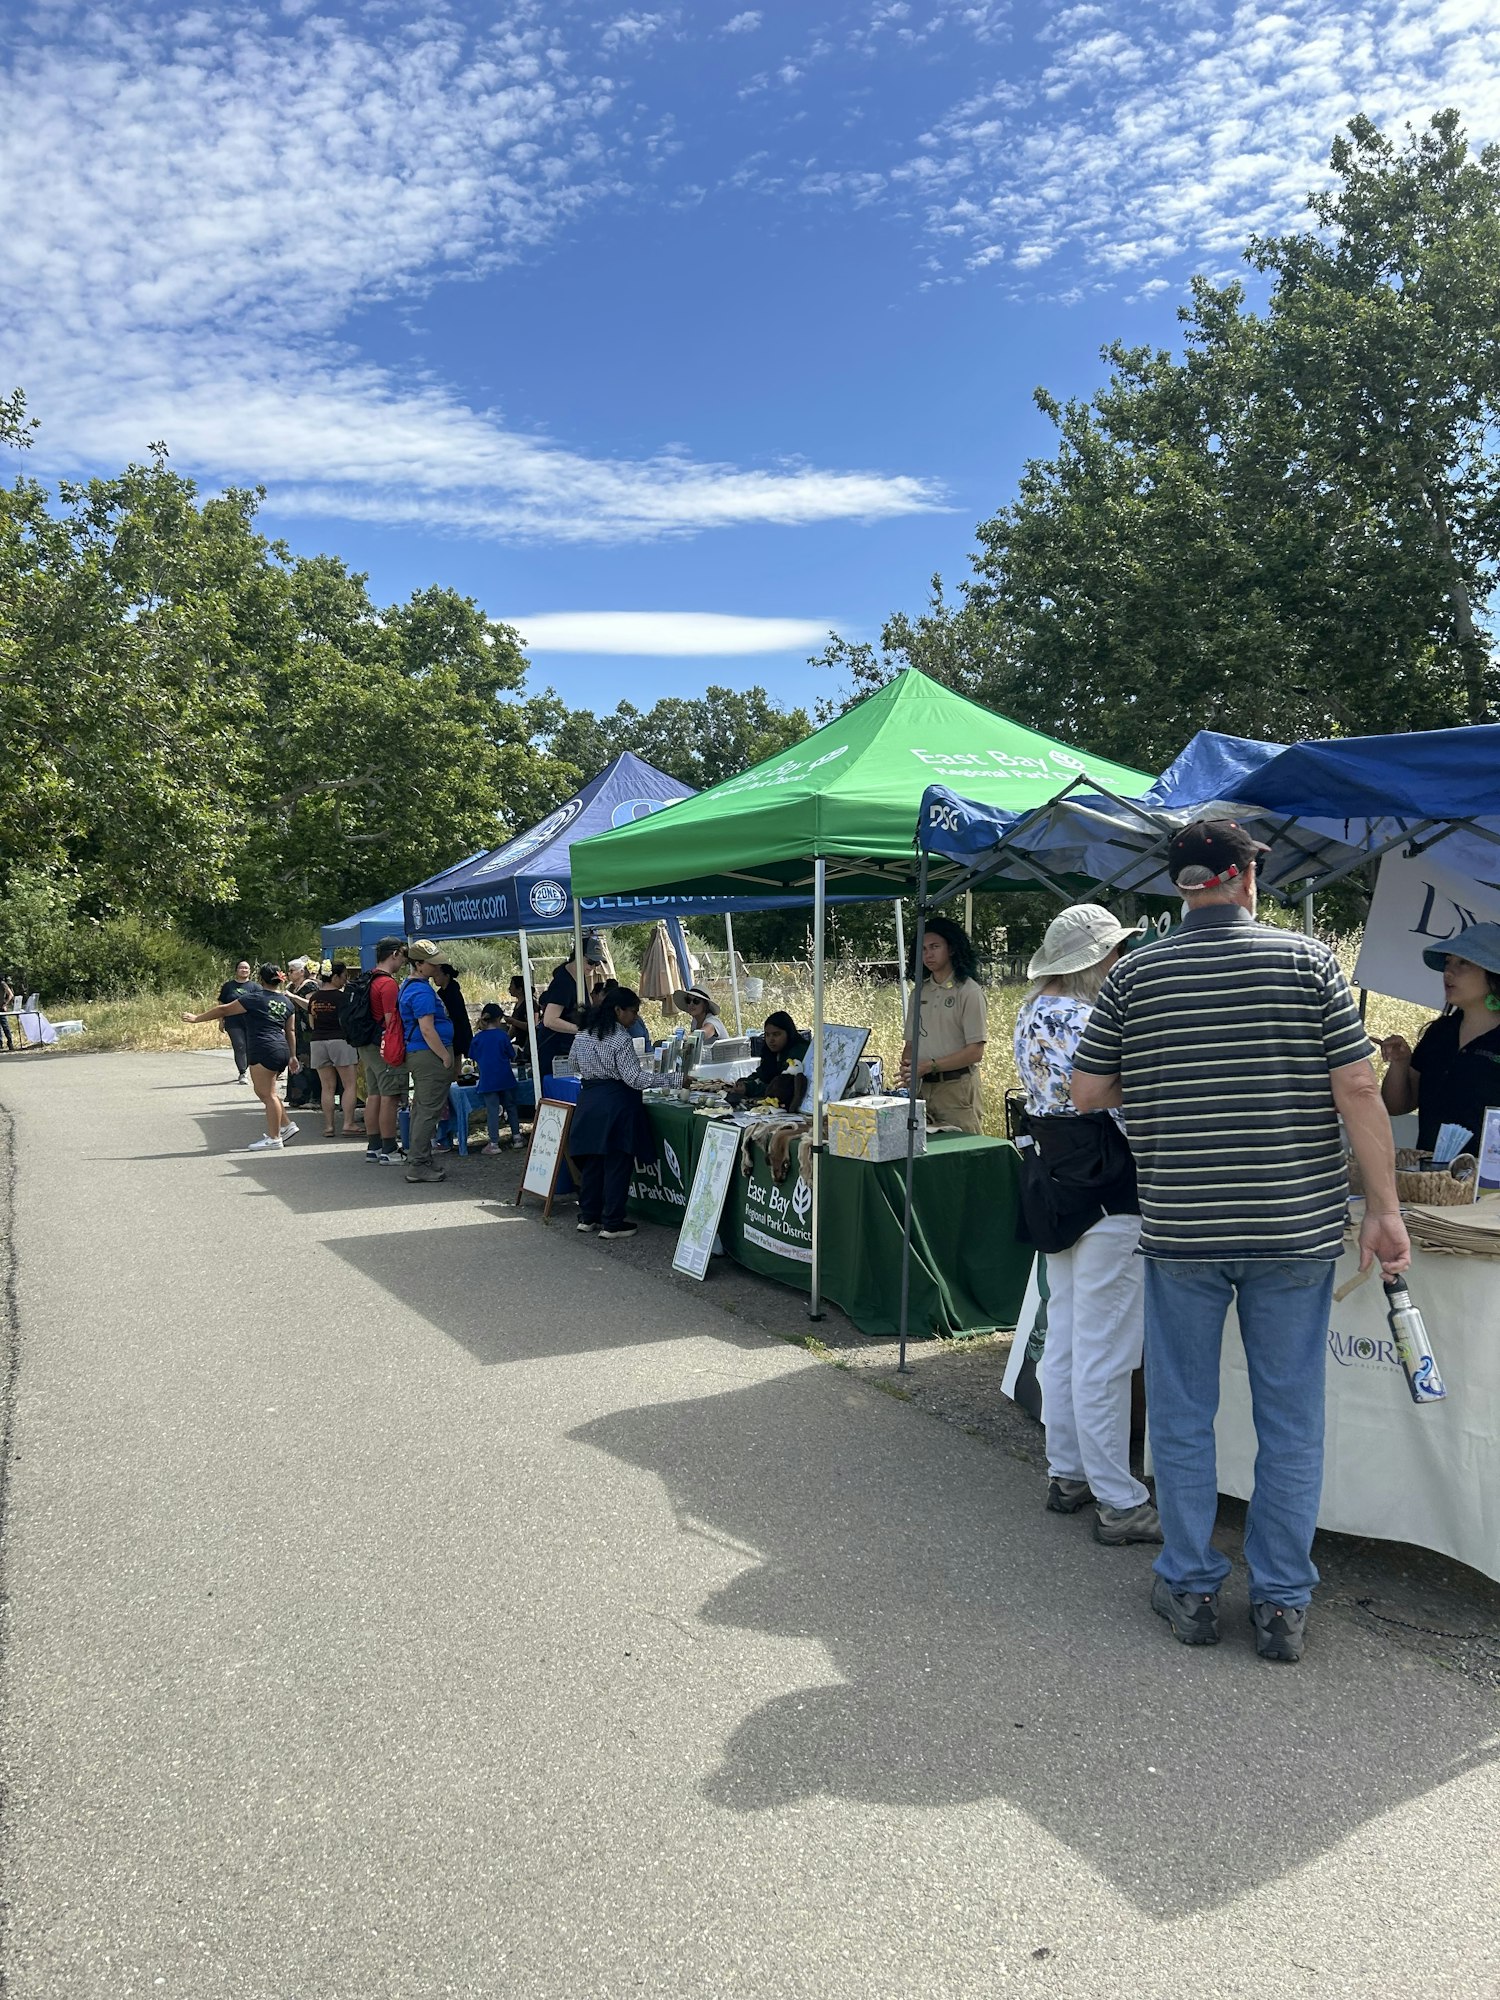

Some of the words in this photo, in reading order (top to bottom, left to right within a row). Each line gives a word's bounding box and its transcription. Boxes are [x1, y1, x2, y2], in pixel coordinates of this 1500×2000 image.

[911, 748, 989, 766] East
[985, 750, 1048, 773] Bay
[932, 767, 1011, 778] Regional
[1009, 769, 1054, 780] Park
[930, 804, 962, 832] DSG
[537, 886, 560, 899] ZONE
[424, 894, 508, 926] zone7water.com
[540, 899, 558, 912] 7
[638, 1182, 666, 1202] Park
[747, 1175, 767, 1205] East
[769, 1186, 790, 1221] Bay
[745, 1203, 766, 1225] Regional
[767, 1214, 782, 1232] Park
